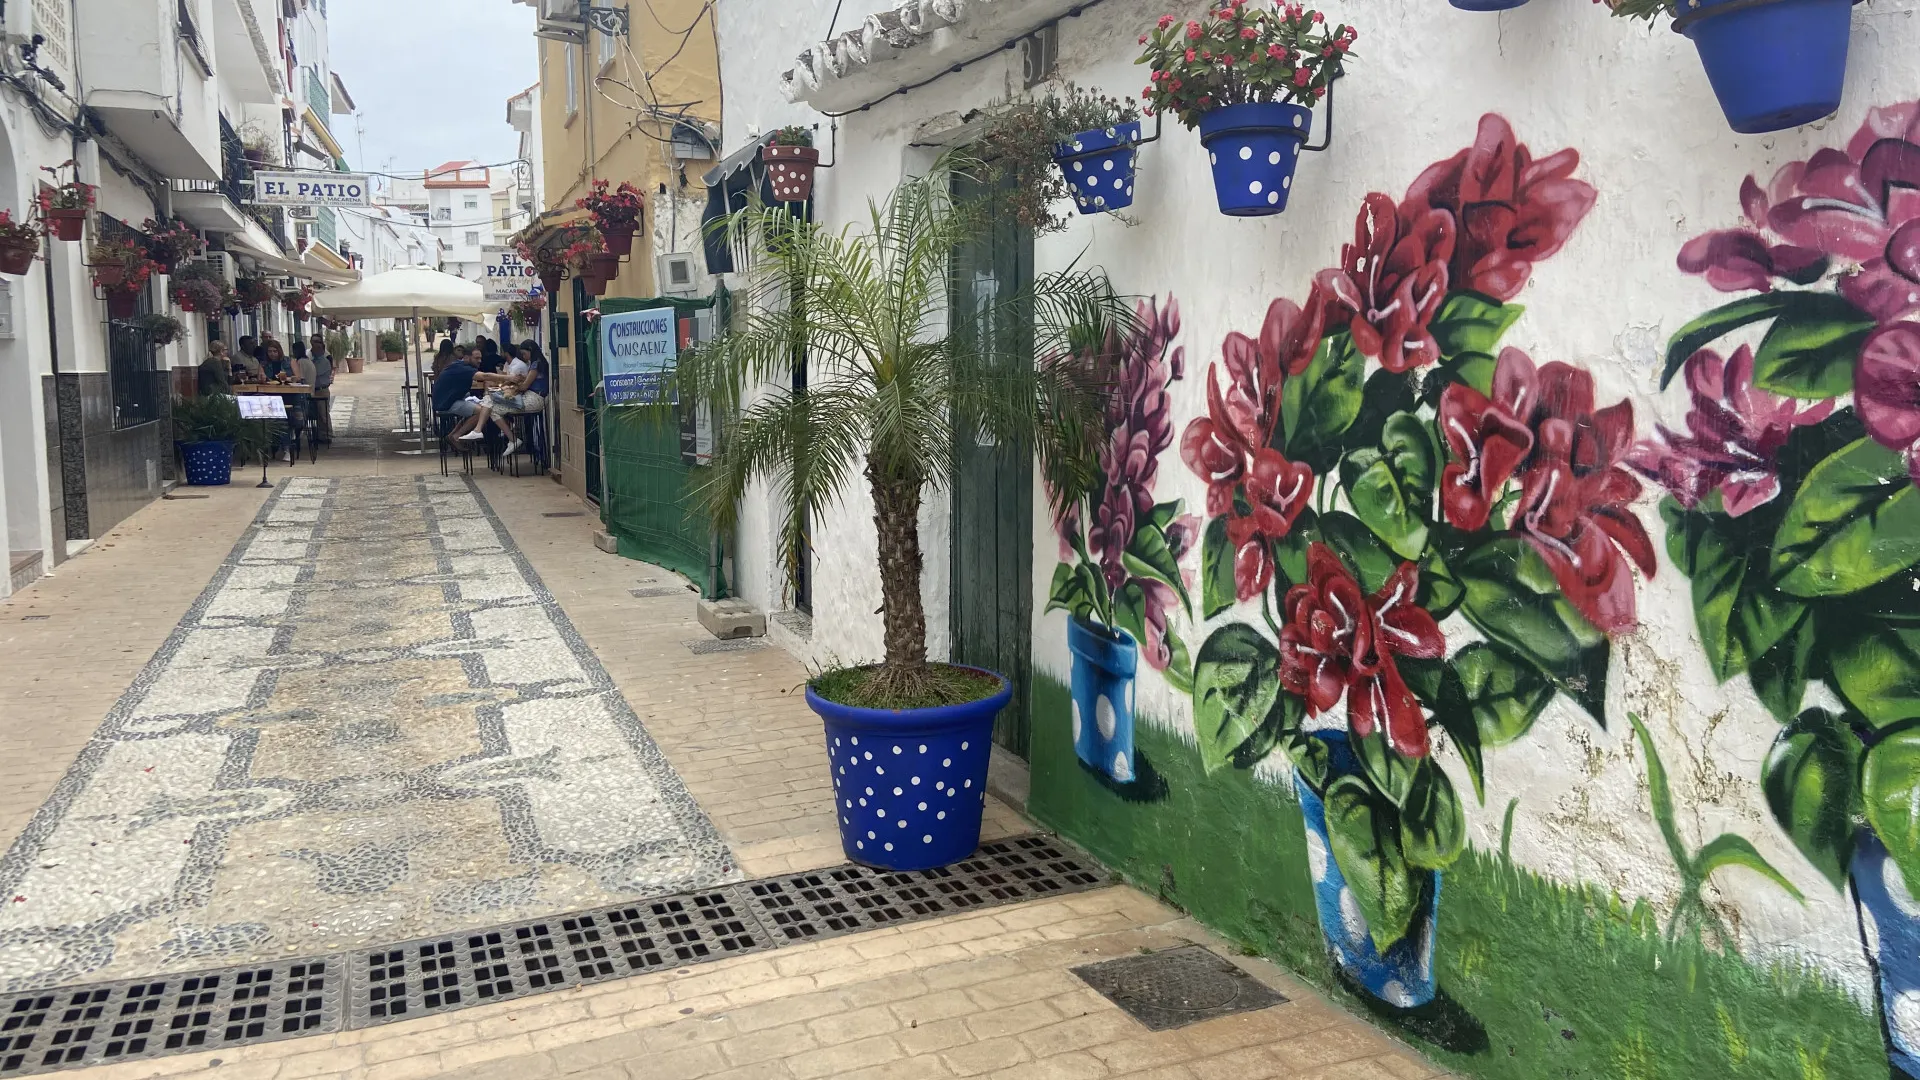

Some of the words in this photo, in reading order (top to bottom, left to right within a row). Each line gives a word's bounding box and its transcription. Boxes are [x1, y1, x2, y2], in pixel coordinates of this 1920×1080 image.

[264, 182, 290, 195] EL
[298, 183, 361, 197] PATIO
[501, 253, 521, 265] EL
[486, 265, 536, 277] PATIO
